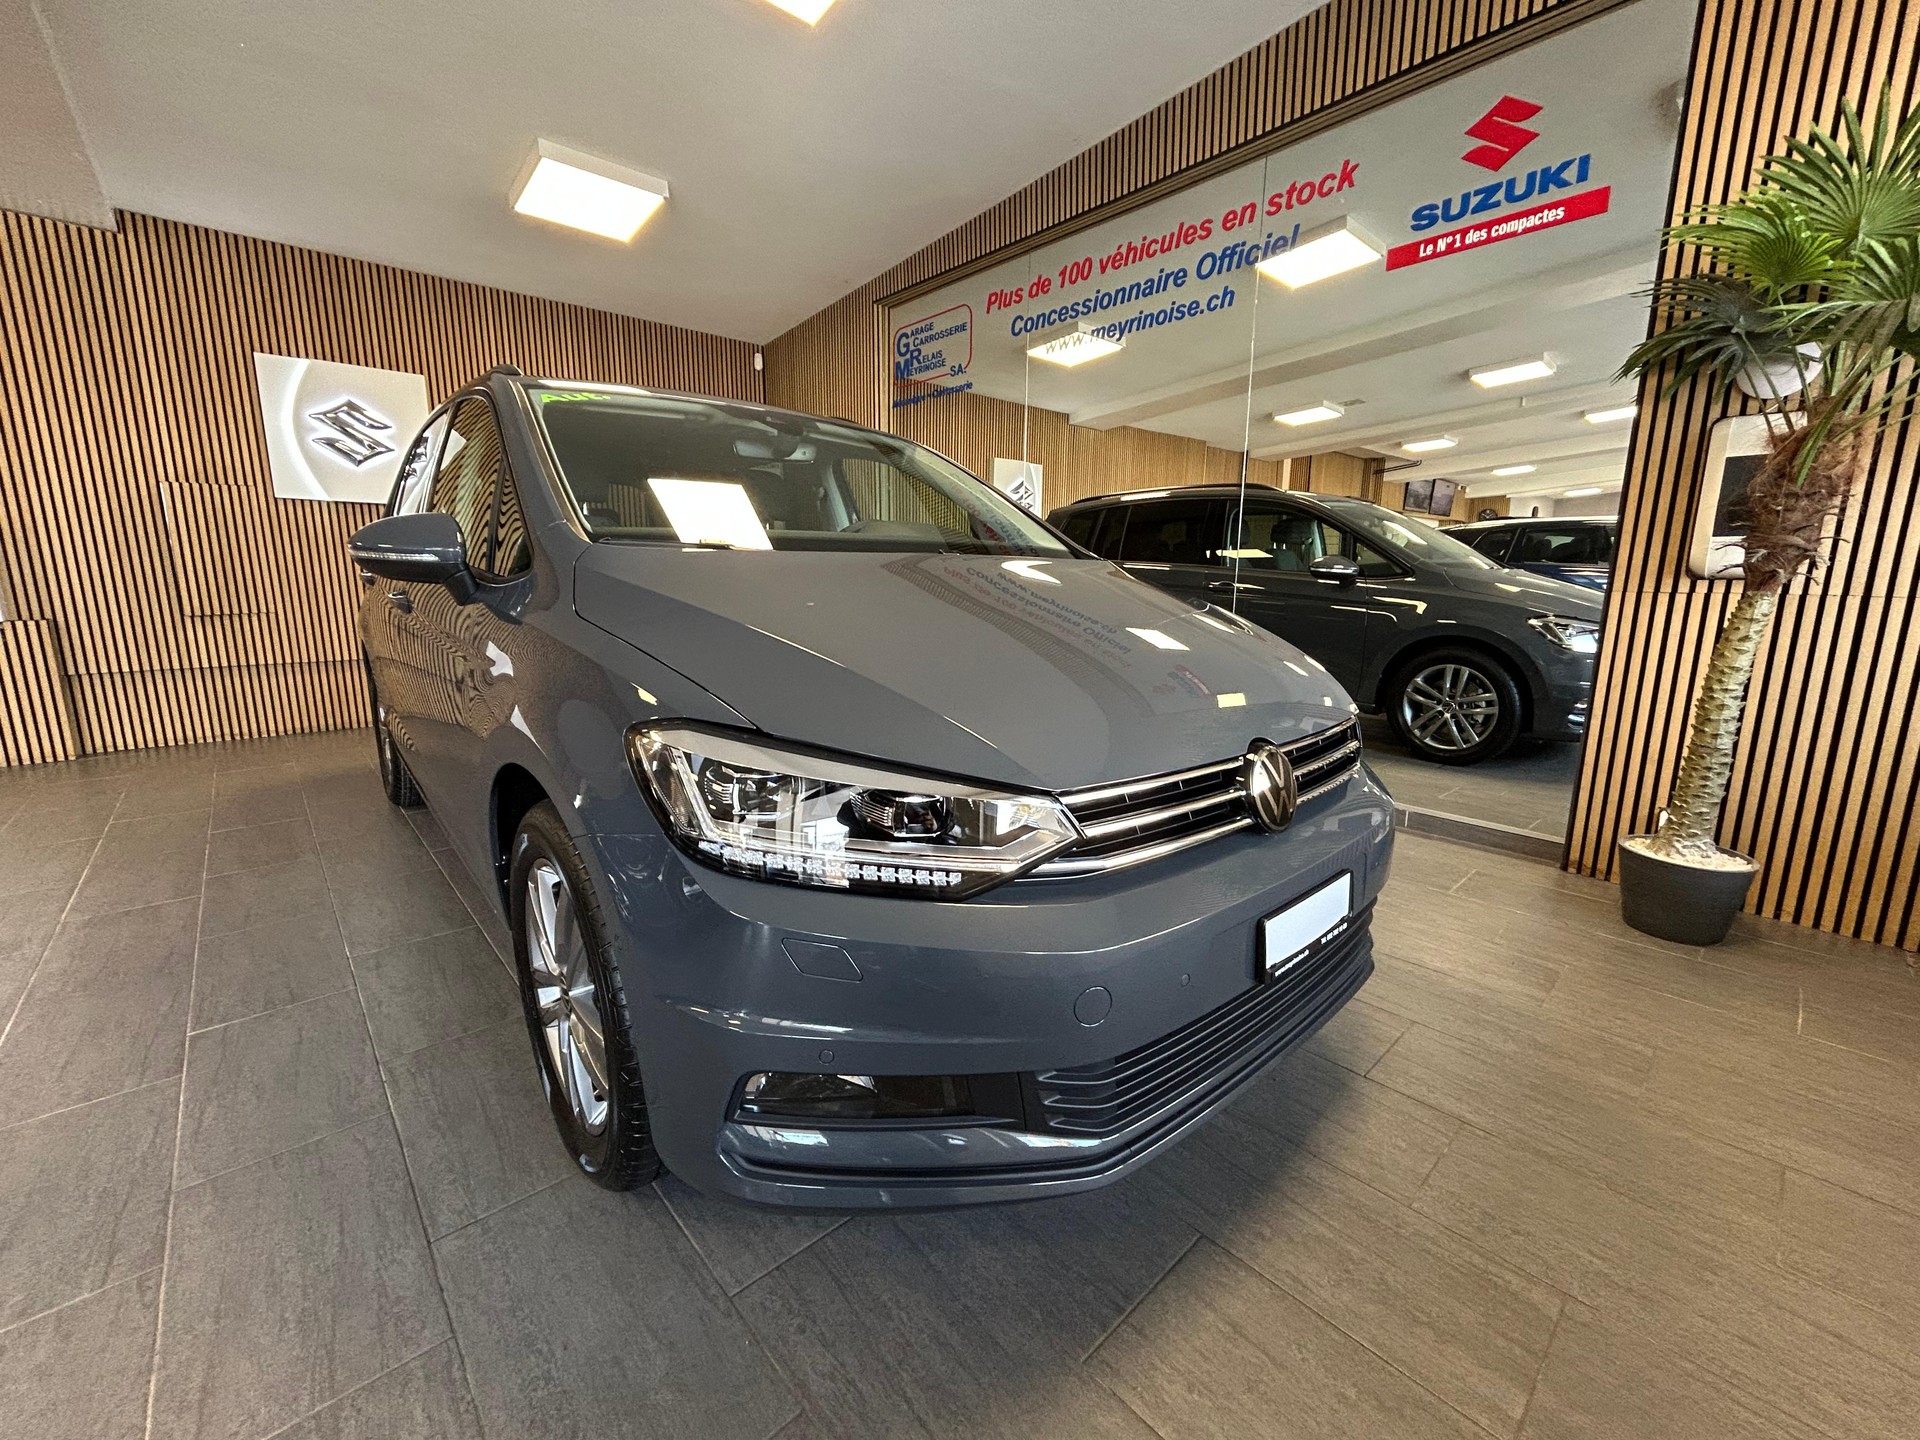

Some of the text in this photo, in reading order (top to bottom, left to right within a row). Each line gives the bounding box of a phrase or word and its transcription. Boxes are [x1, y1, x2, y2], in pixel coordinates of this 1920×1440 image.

[1410, 153, 1591, 232] SUZUKI
[986, 159, 1360, 314] Plus de 100 véhicules en stock
[1419, 243, 1433, 258] Le
[1465, 228, 1488, 245] des
[1491, 206, 1565, 238] compactes
[1011, 223, 1300, 337] Concessionnaire Officiel
[896, 322, 934, 357] GARAGE
[913, 322, 968, 348] CARROSSERIE
[1045, 285, 1236, 355] www.meyrinoise.ch
[895, 358, 947, 381] MEYRINOISE
[909, 348, 943, 368] RELAIS
